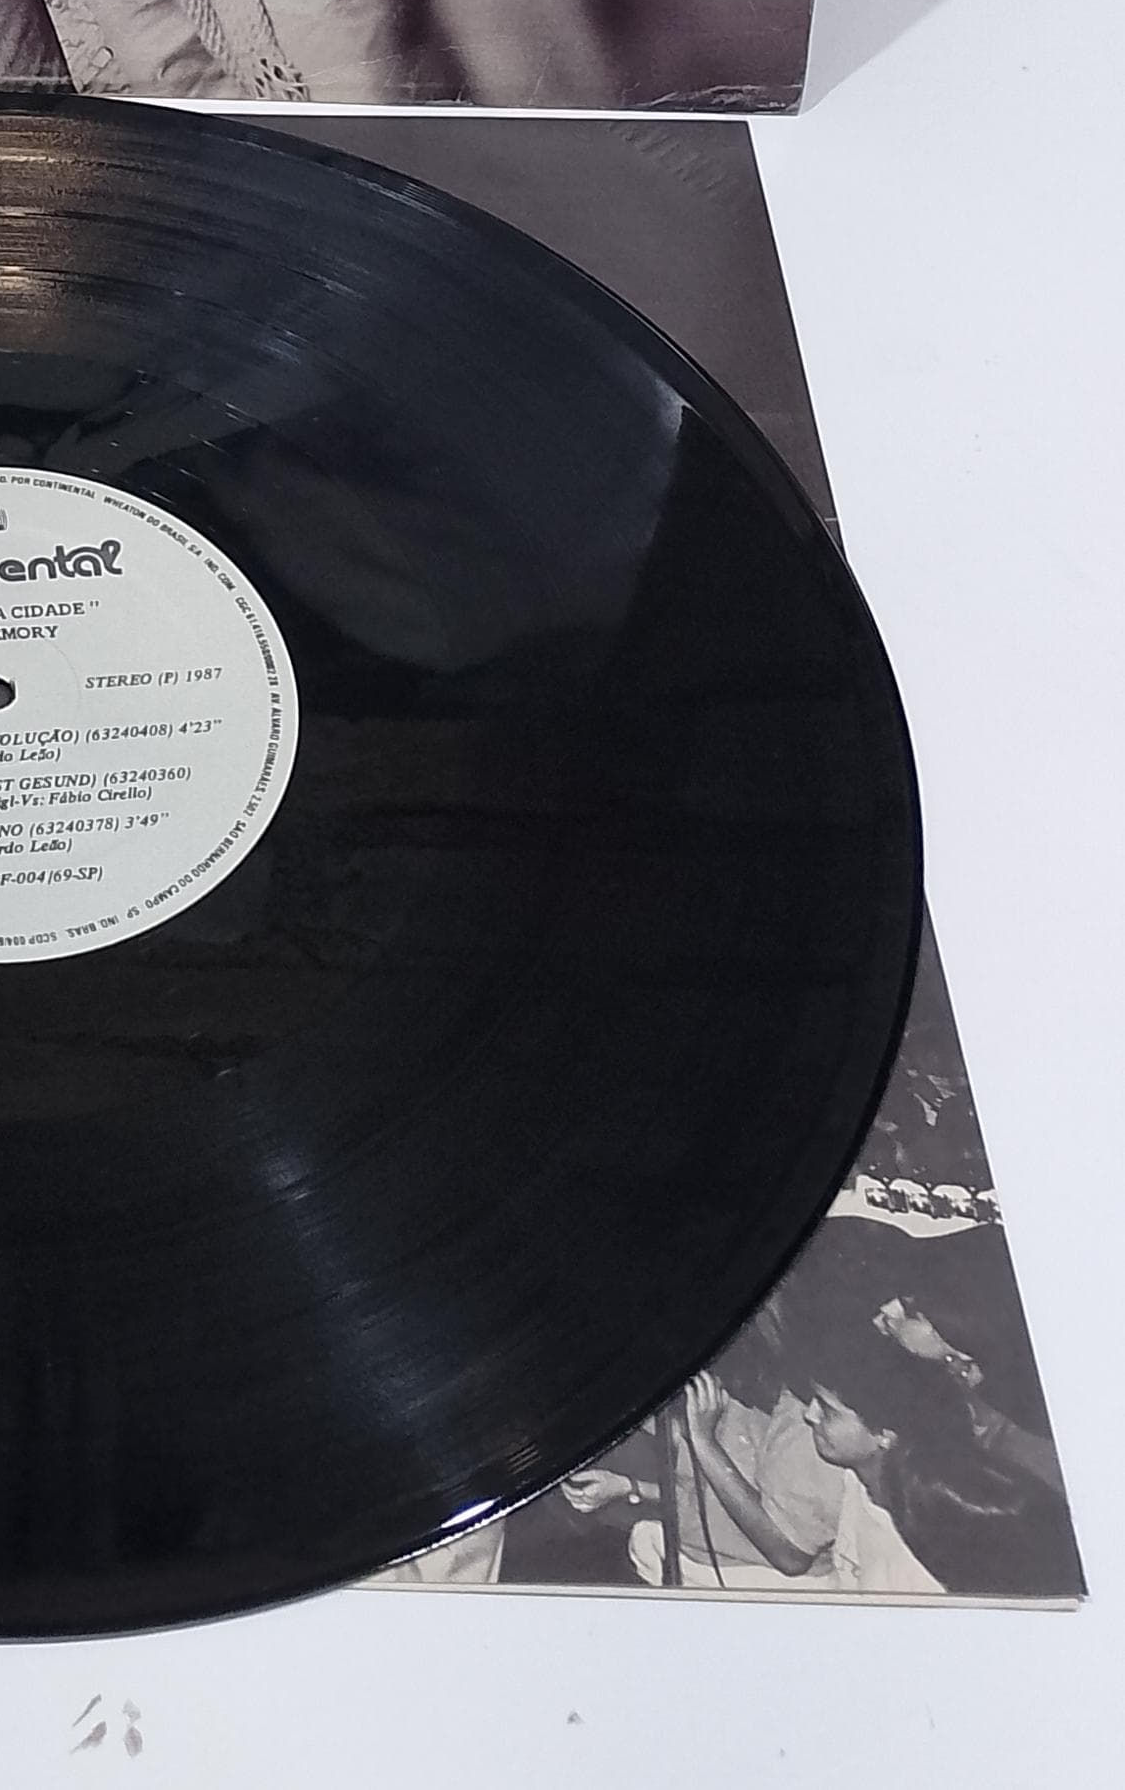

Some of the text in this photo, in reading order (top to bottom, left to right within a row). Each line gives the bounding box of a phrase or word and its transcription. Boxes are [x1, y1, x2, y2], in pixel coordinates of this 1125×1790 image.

[10, 475, 31, 485] POR
[32, 478, 96, 499] CONTINENTAL
[103, 495, 147, 519] WHEATON
[146, 515, 161, 527] DO
[235, 596, 252, 614] CGC
[85, 667, 223, 690] STEREO (P) 1987
[85, 723, 174, 743] (63240408)
[19, 773, 97, 791] GESUND)
[103, 766, 192, 787] (63240360)
[48, 790, 92, 805] Fábio
[97, 786, 153, 802] Cirello)
[29, 817, 120, 839] (63240378)
[29, 838, 73, 853] Leão)
[190, 837, 234, 878] BERNARDO
[177, 874, 194, 888] DO
[144, 884, 180, 909] CAMPO
[126, 906, 140, 919] SP
